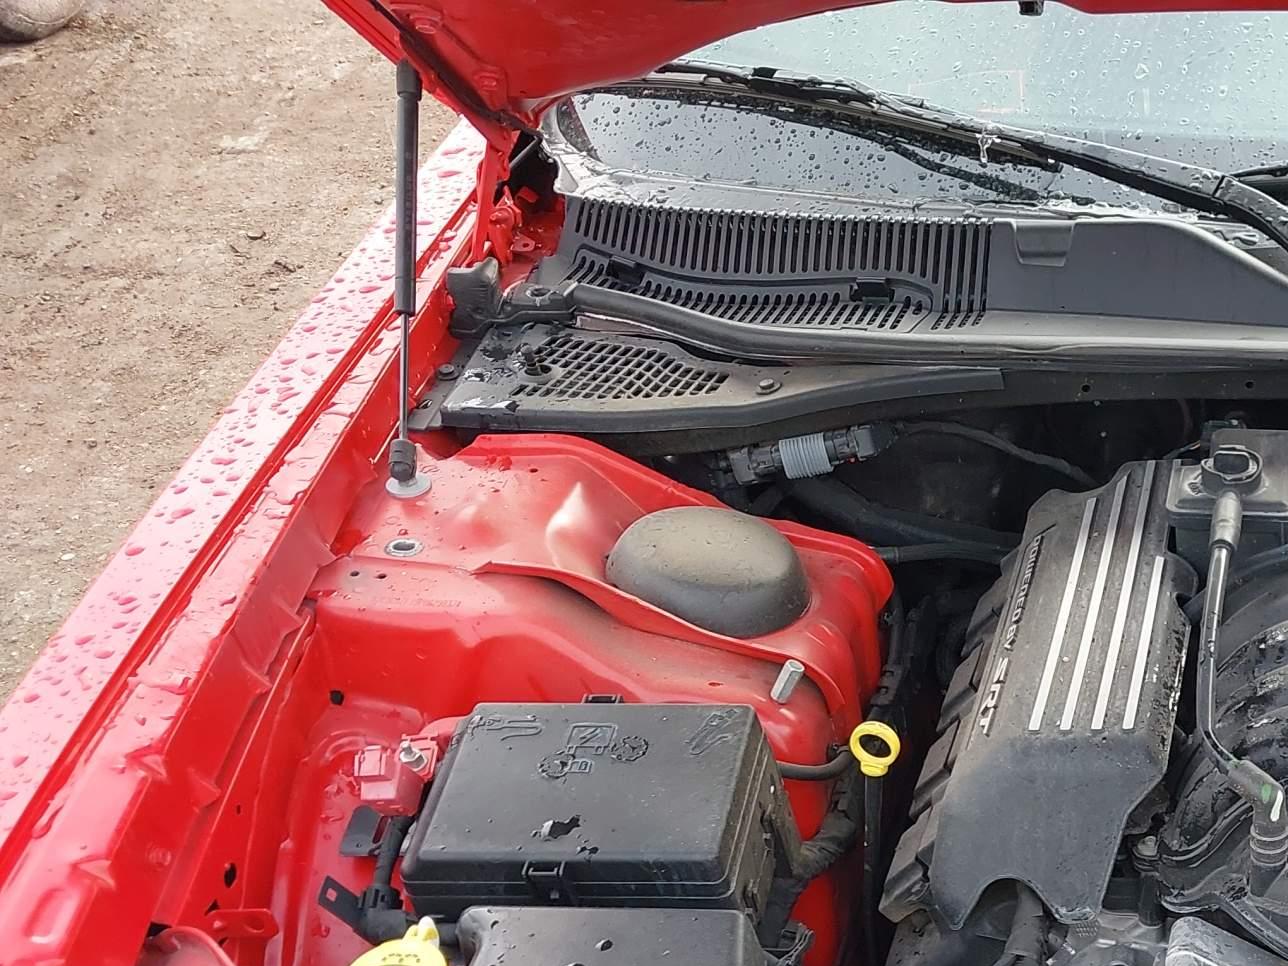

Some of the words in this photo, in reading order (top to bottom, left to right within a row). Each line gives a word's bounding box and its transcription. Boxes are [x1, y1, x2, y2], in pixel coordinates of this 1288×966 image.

[1011, 534, 1042, 621] POWERED
[1003, 624, 1018, 649] BY
[979, 657, 1009, 735] SRT
